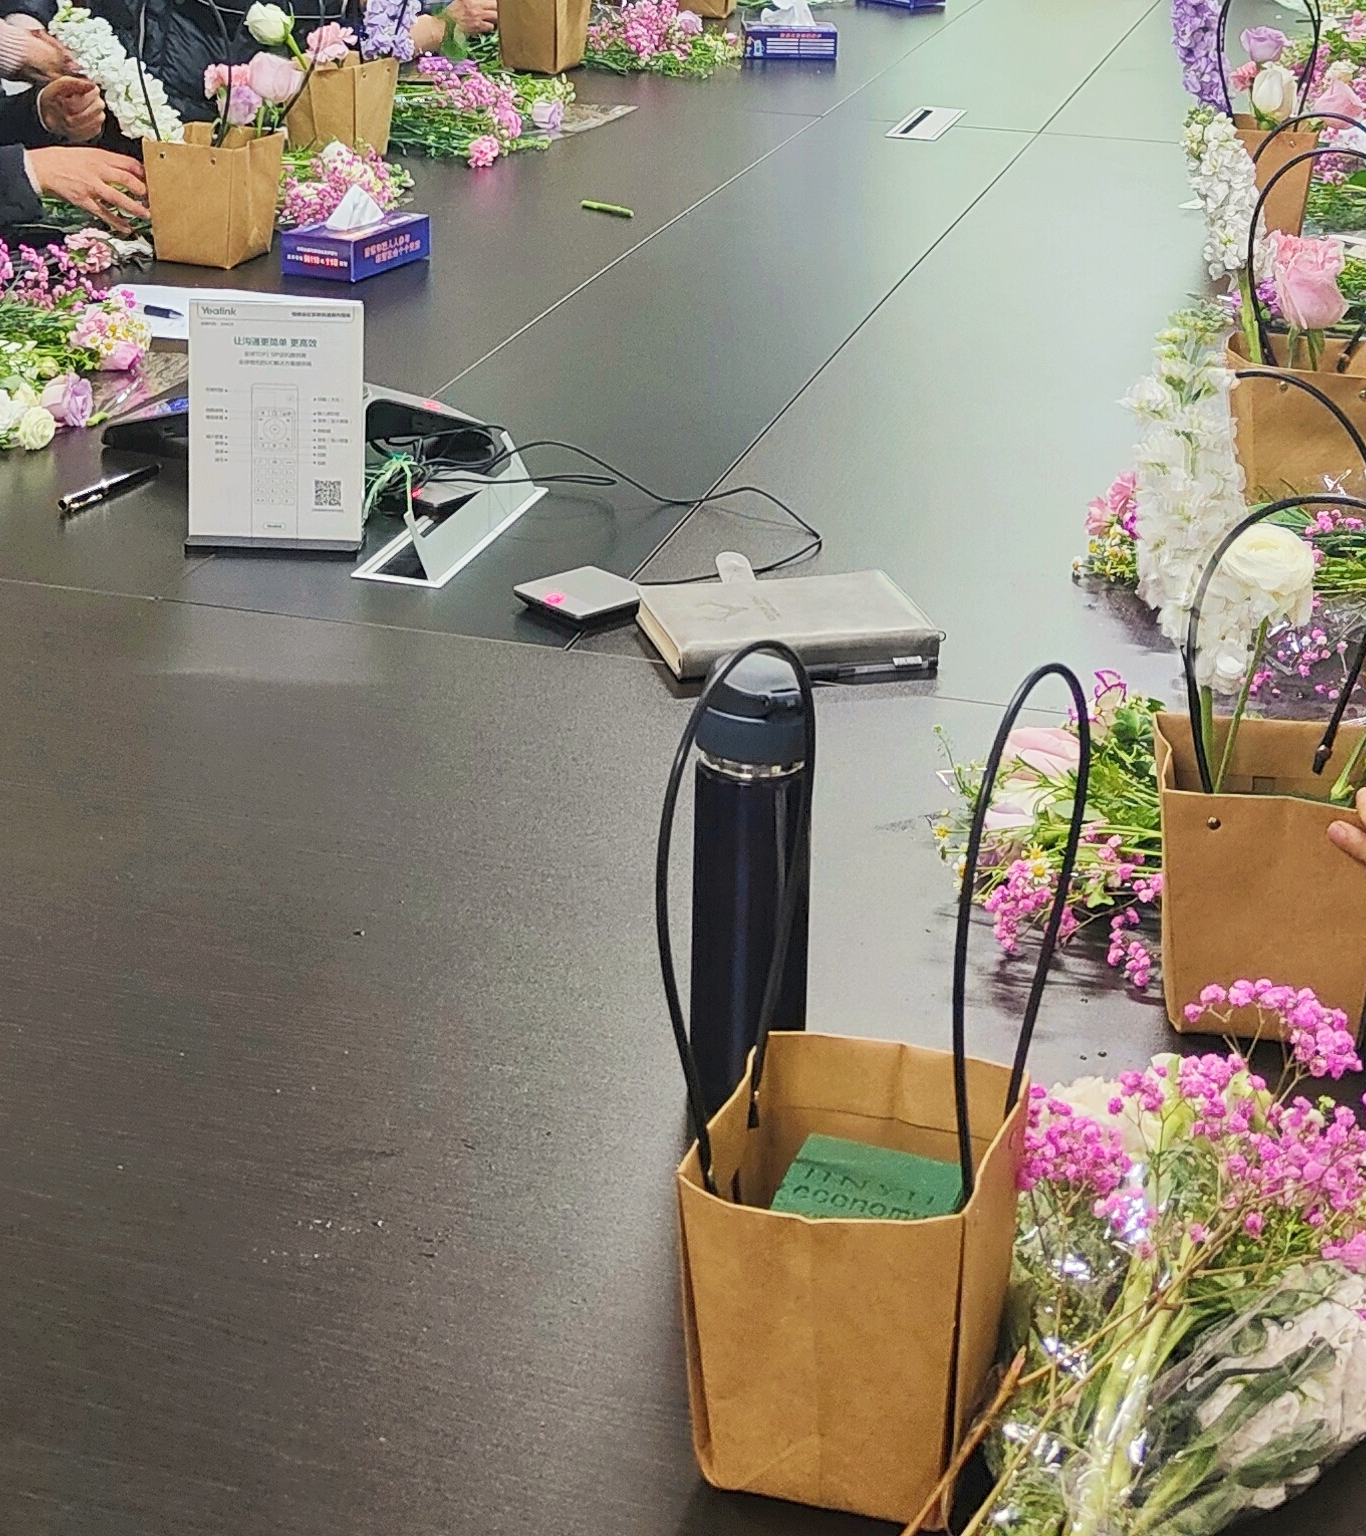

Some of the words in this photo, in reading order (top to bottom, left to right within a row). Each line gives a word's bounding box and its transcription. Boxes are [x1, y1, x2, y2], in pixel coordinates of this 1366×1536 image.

[201, 306, 236, 316] Yealink
[234, 336, 287, 347] 让沟通更简单
[290, 337, 317, 348] 更高效
